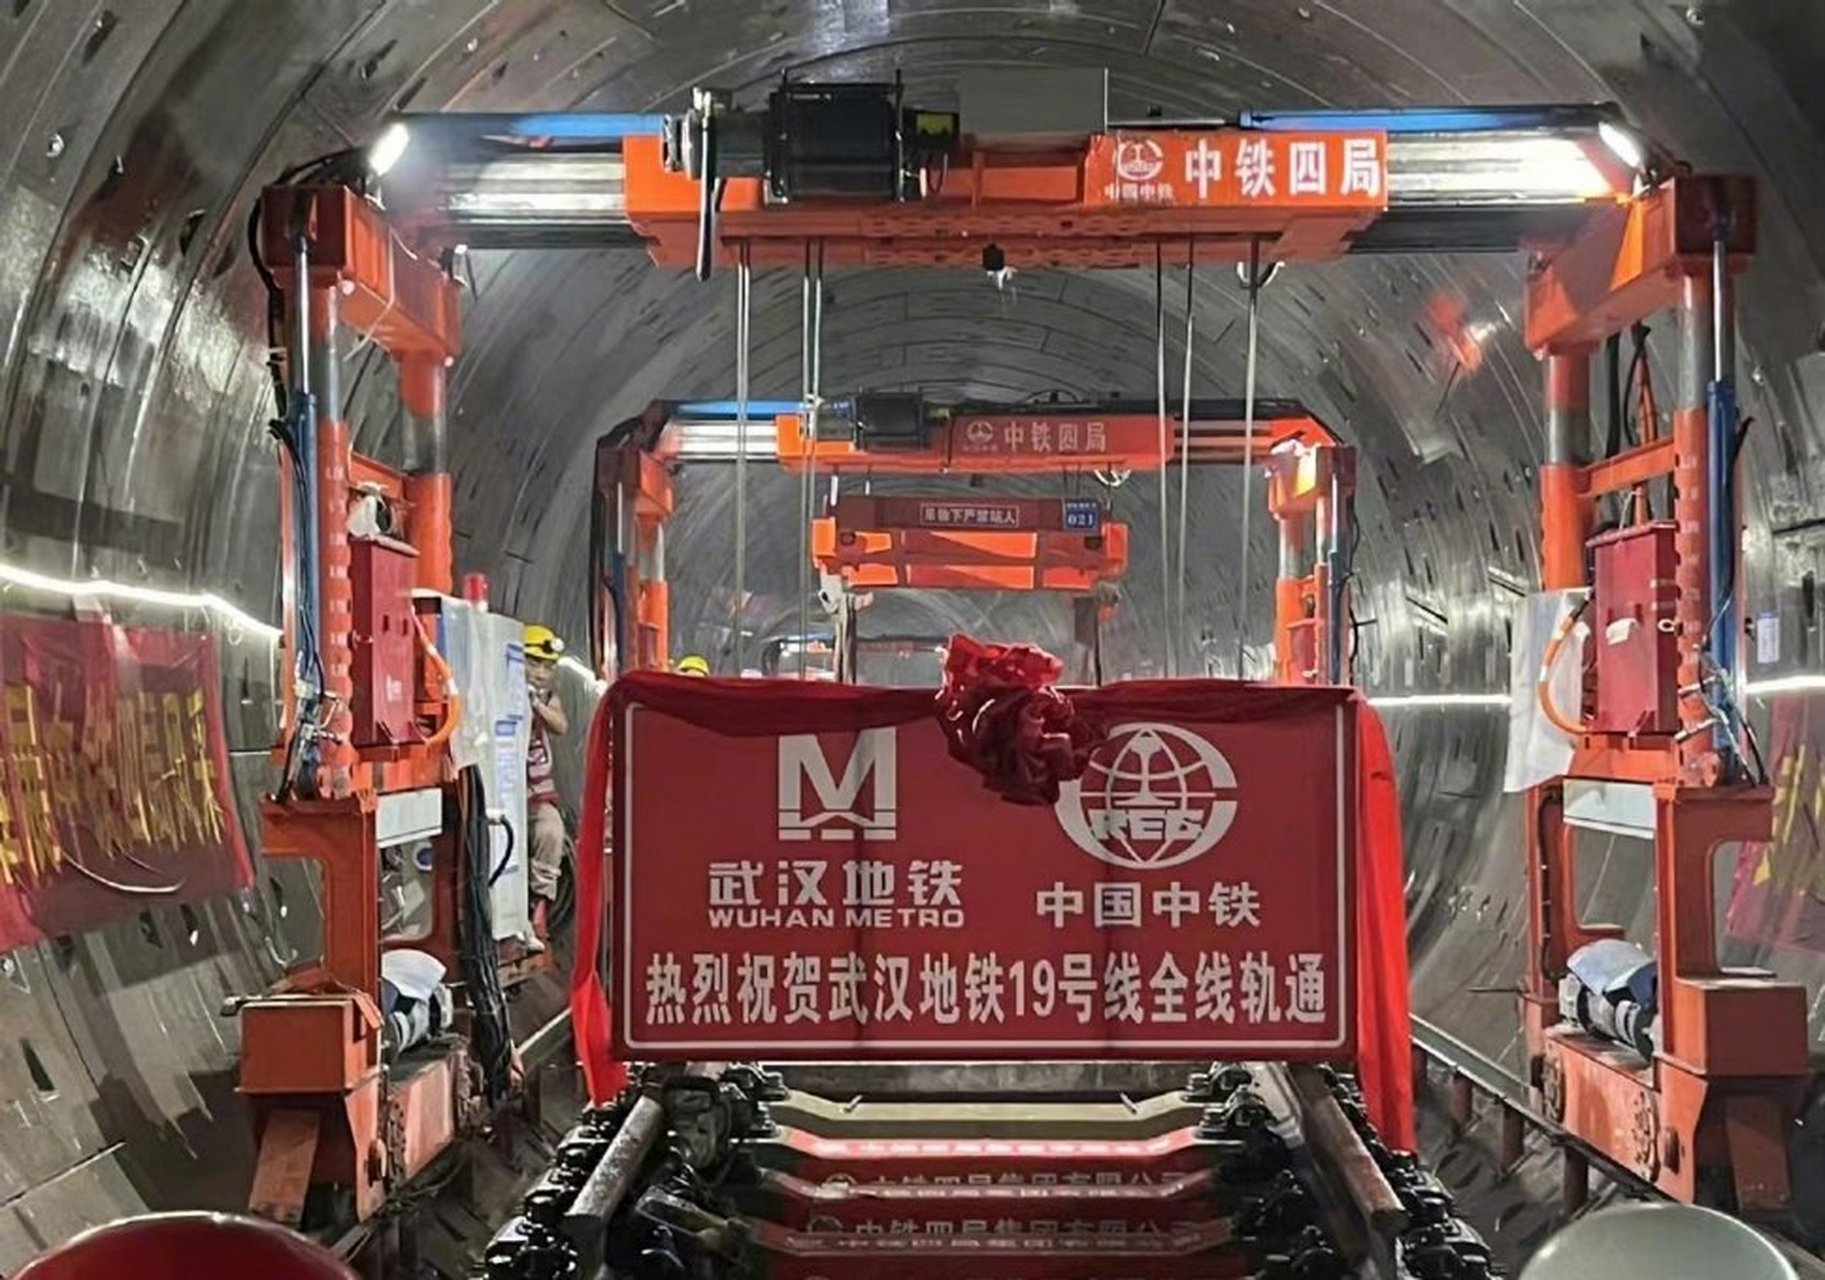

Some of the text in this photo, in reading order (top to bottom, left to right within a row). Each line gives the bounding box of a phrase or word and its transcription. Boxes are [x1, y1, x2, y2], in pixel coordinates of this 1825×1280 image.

[1184, 137, 1381, 200] 中铁四局
[1003, 420, 1107, 453] 中铁四局
[1067, 513, 1094, 526] 021
[708, 860, 964, 907] 武汉地铁
[1036, 881, 1261, 928] 中国中铁
[708, 908, 965, 929] WUHAN METRO
[645, 952, 1327, 1026] 热烈祝贺武汉地铁19号线全线轨通
